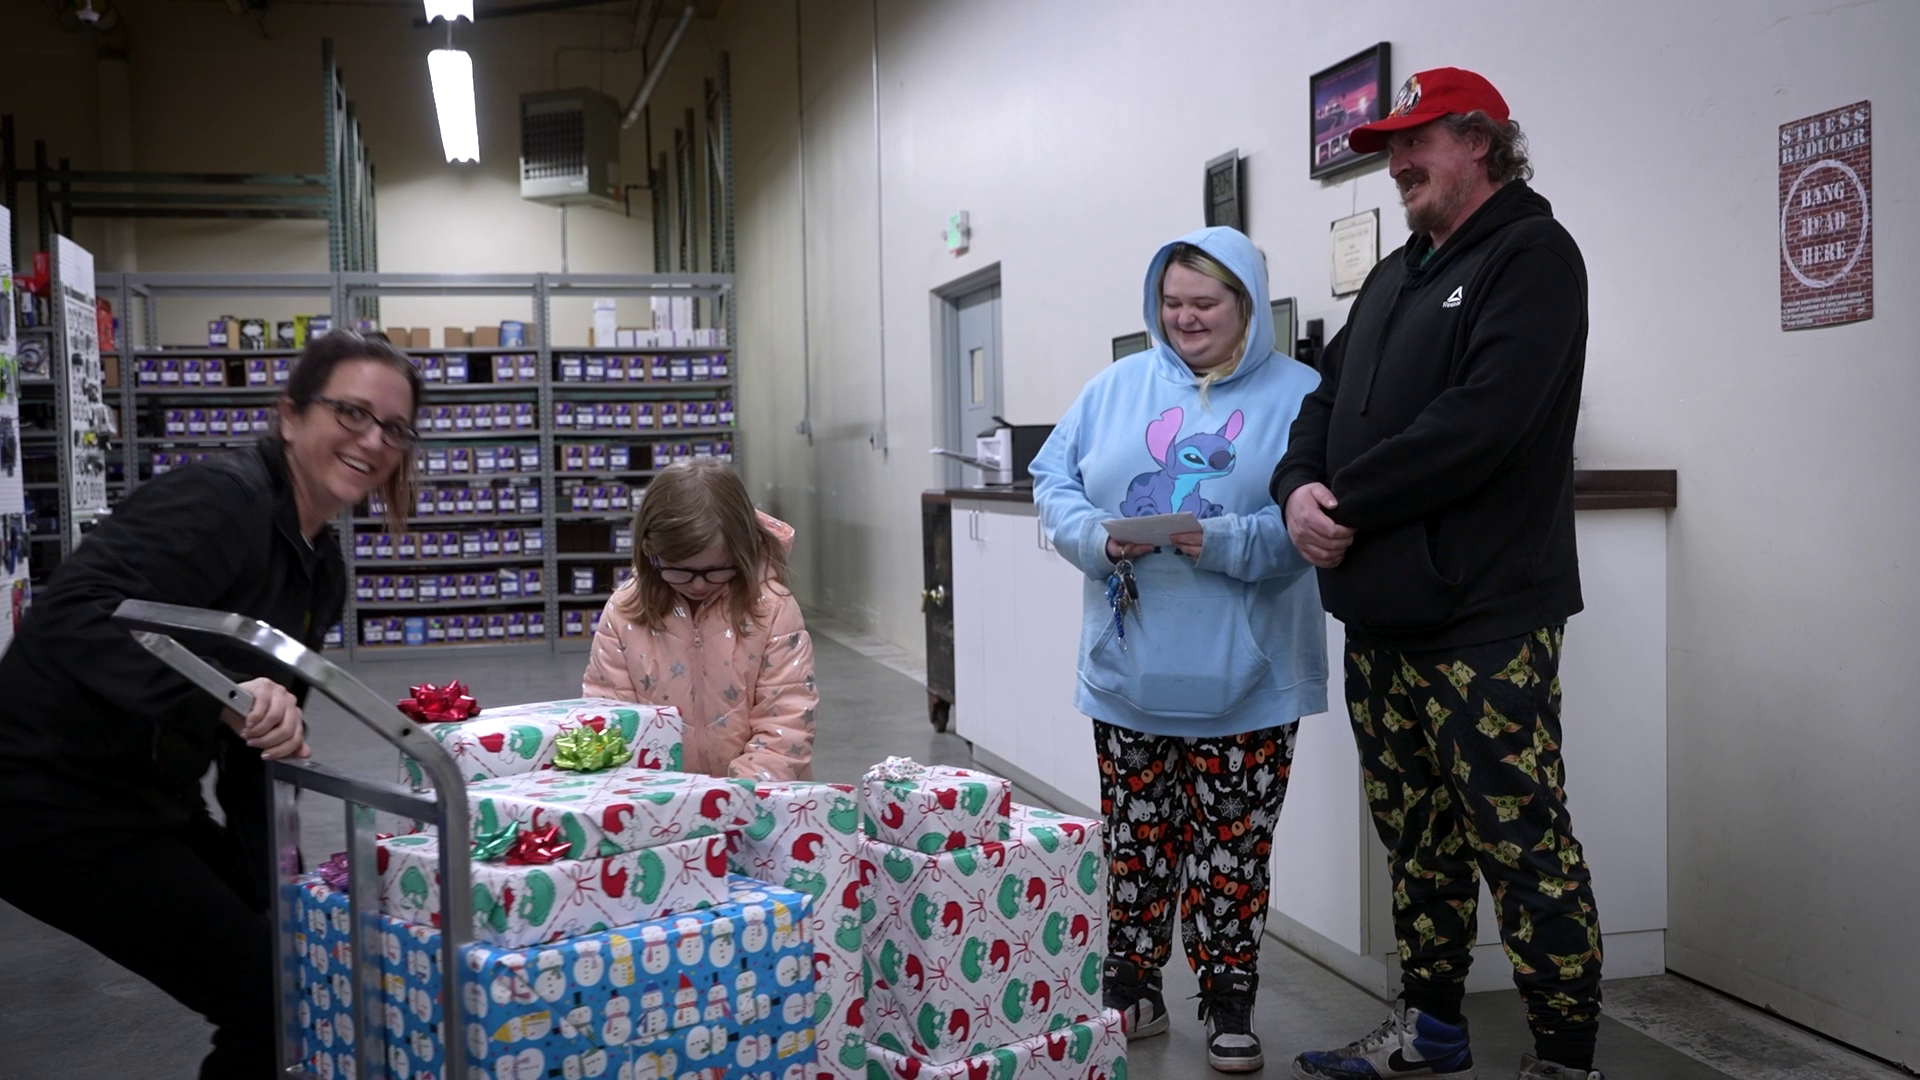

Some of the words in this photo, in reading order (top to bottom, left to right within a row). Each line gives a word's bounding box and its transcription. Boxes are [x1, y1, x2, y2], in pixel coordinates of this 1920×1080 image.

[1781, 108, 1865, 146] STRESS
[1782, 128, 1866, 164] REDUCER
[1802, 181, 1845, 208] BANG
[1801, 211, 1846, 236] HEAD
[1802, 241, 1846, 266] HERE
[1127, 760, 1163, 793] BOO
[1239, 890, 1267, 920] BOO
